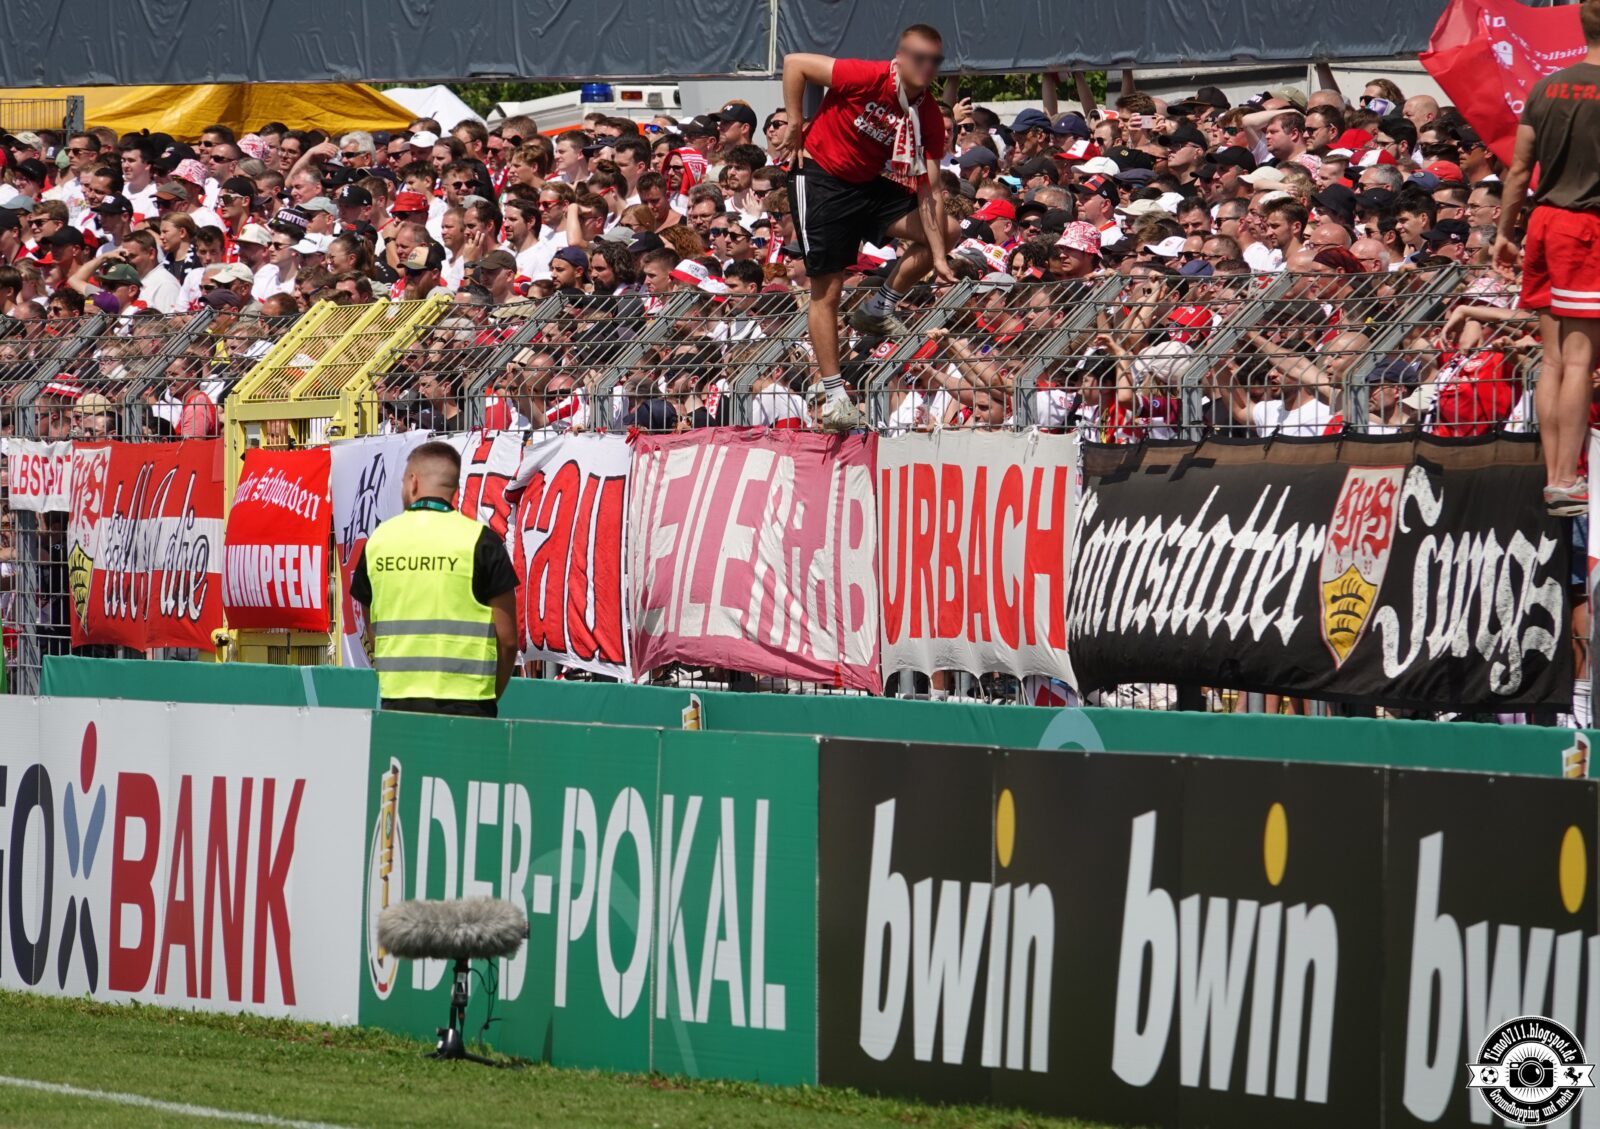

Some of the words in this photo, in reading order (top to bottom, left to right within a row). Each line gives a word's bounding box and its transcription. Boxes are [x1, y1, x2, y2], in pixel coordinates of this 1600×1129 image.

[375, 556, 459, 571] SECURITY
[881, 463, 1067, 650] URBACH
[1372, 465, 1564, 696] Jungs
[108, 771, 306, 1006] BANK
[412, 776, 786, 1031] DFB-POKAL
[859, 788, 1055, 1073] bwin
[1111, 802, 1338, 1104] bwin
